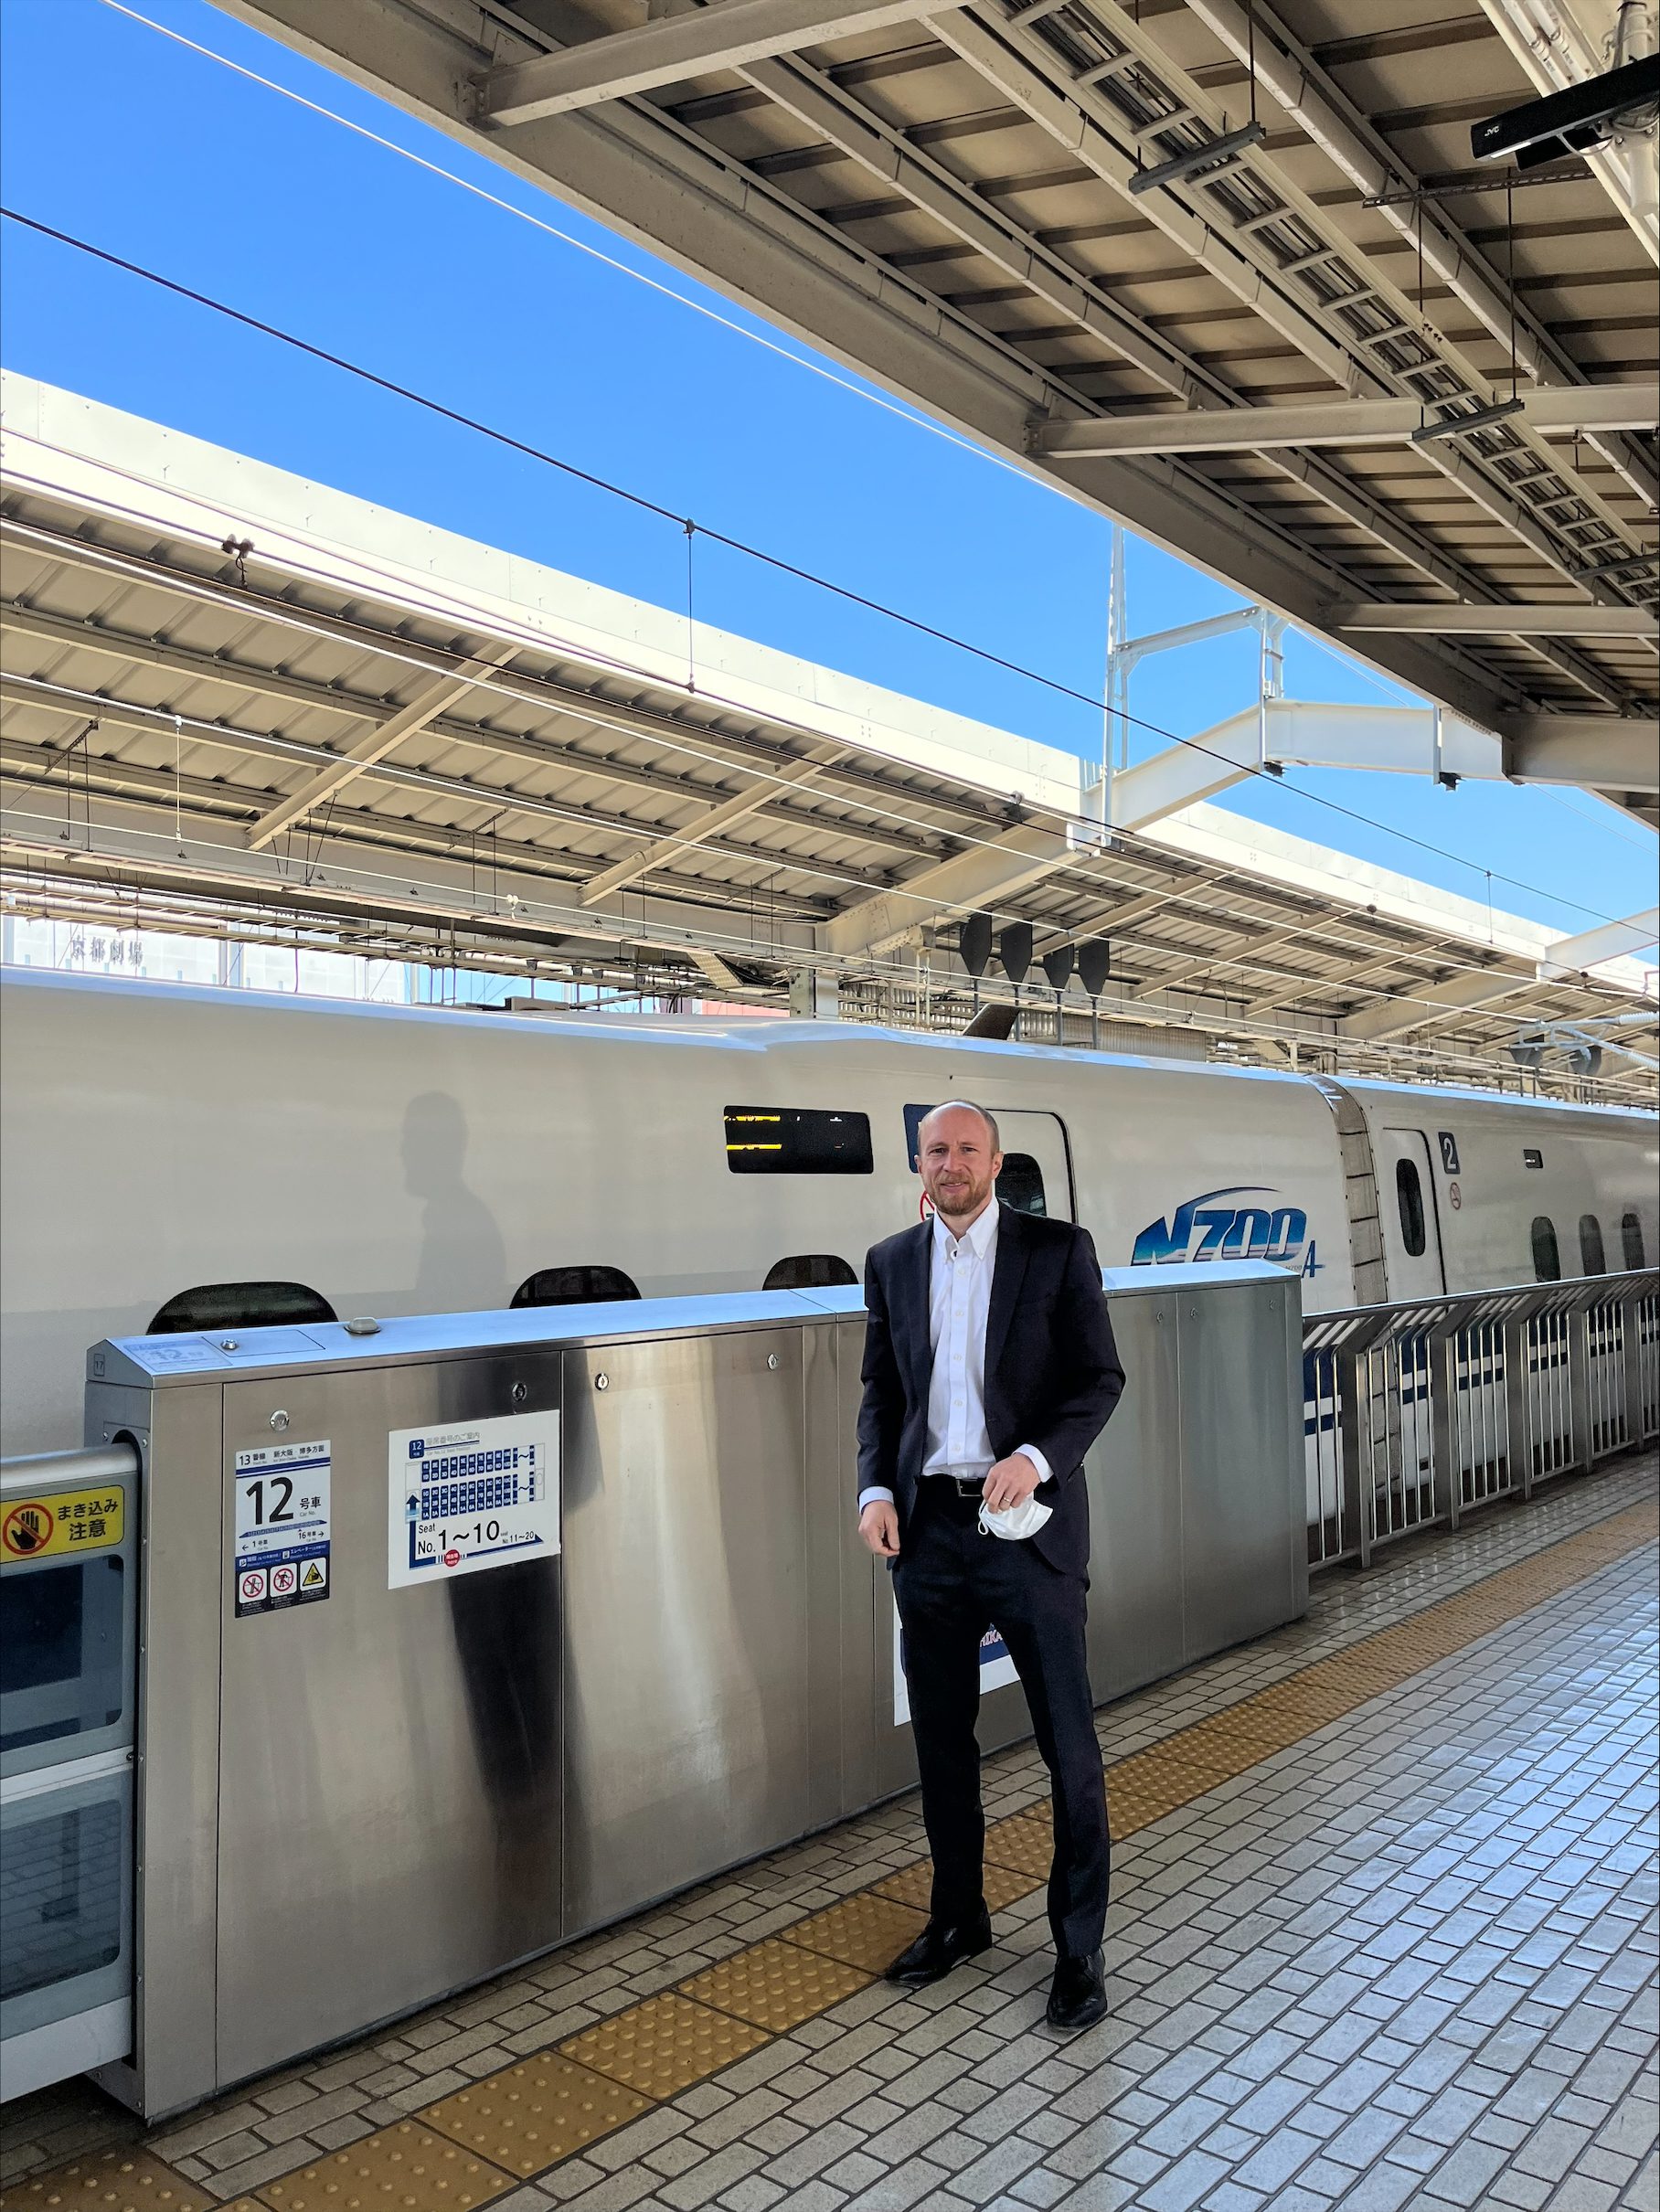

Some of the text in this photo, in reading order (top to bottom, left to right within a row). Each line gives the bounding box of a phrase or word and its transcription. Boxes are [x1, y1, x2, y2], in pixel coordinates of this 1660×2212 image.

[1484, 125, 1500, 137] JVC
[1443, 1137, 1457, 1169] 2
[1131, 1186, 1307, 1267] N700
[411, 1441, 422, 1451] 12
[239, 1454, 250, 1466] 13
[245, 1476, 322, 1526] 12 号車
[57, 1498, 119, 1521] まき込み
[69, 1519, 107, 1541] 注意
[298, 1531, 307, 1539] 16
[418, 1523, 436, 1534] Seat
[418, 1541, 436, 1555] No.
